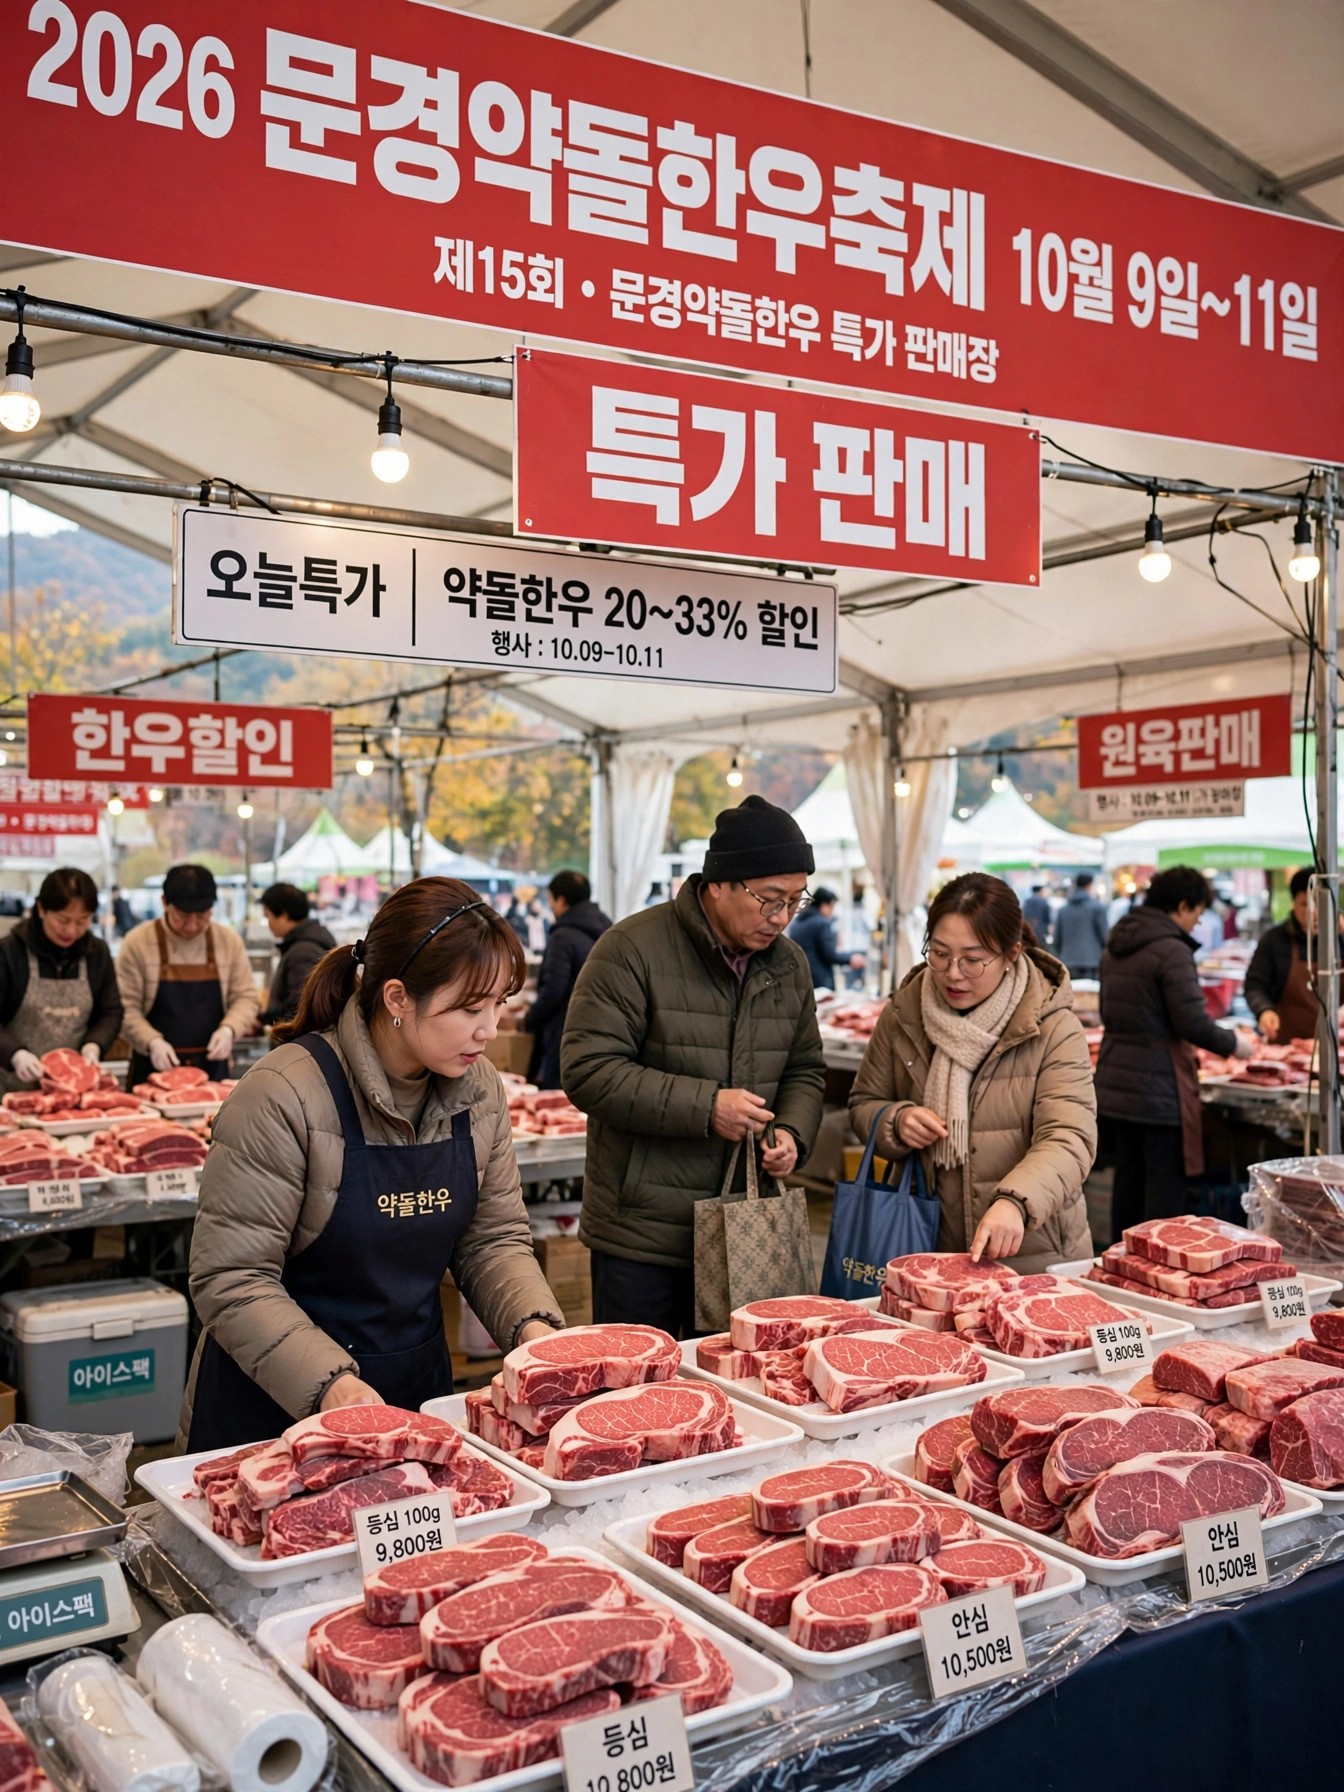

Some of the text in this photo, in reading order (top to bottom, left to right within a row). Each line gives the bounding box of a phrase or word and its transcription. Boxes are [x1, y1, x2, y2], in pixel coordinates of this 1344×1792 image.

[26, 0, 1319, 363] 2026 문경약돌한우축제 10월 9일~11일
[433, 236, 1000, 384] 제15회 문경약돌한우 특가 판매장
[586, 385, 986, 561] 특가 판매
[206, 549, 387, 618] 오늘특가
[443, 567, 819, 651] 약돌한우 20~33% 할인
[491, 629, 532, 659] 행사
[550, 637, 664, 669] 10.09-10.11
[71, 707, 294, 778] 한우할인
[1099, 708, 1261, 778] 원육판매
[377, 1188, 453, 1218] 약돌한우
[1096, 1325, 1141, 1344] 등심 100g
[1105, 1342, 1145, 1363] 9,800원
[73, 1357, 150, 1389] 아이스팩
[366, 1506, 441, 1535] 등심 100g
[1208, 1521, 1239, 1552] 안심
[375, 1528, 443, 1563] 9,800원
[1198, 1552, 1257, 1588] 10,500원
[8, 1592, 95, 1633] 아이스팩
[951, 1603, 989, 1640] 안심
[941, 1635, 1013, 1679] 10,500원
[602, 1715, 648, 1758] 등심
[586, 1751, 676, 1792] 10800원
